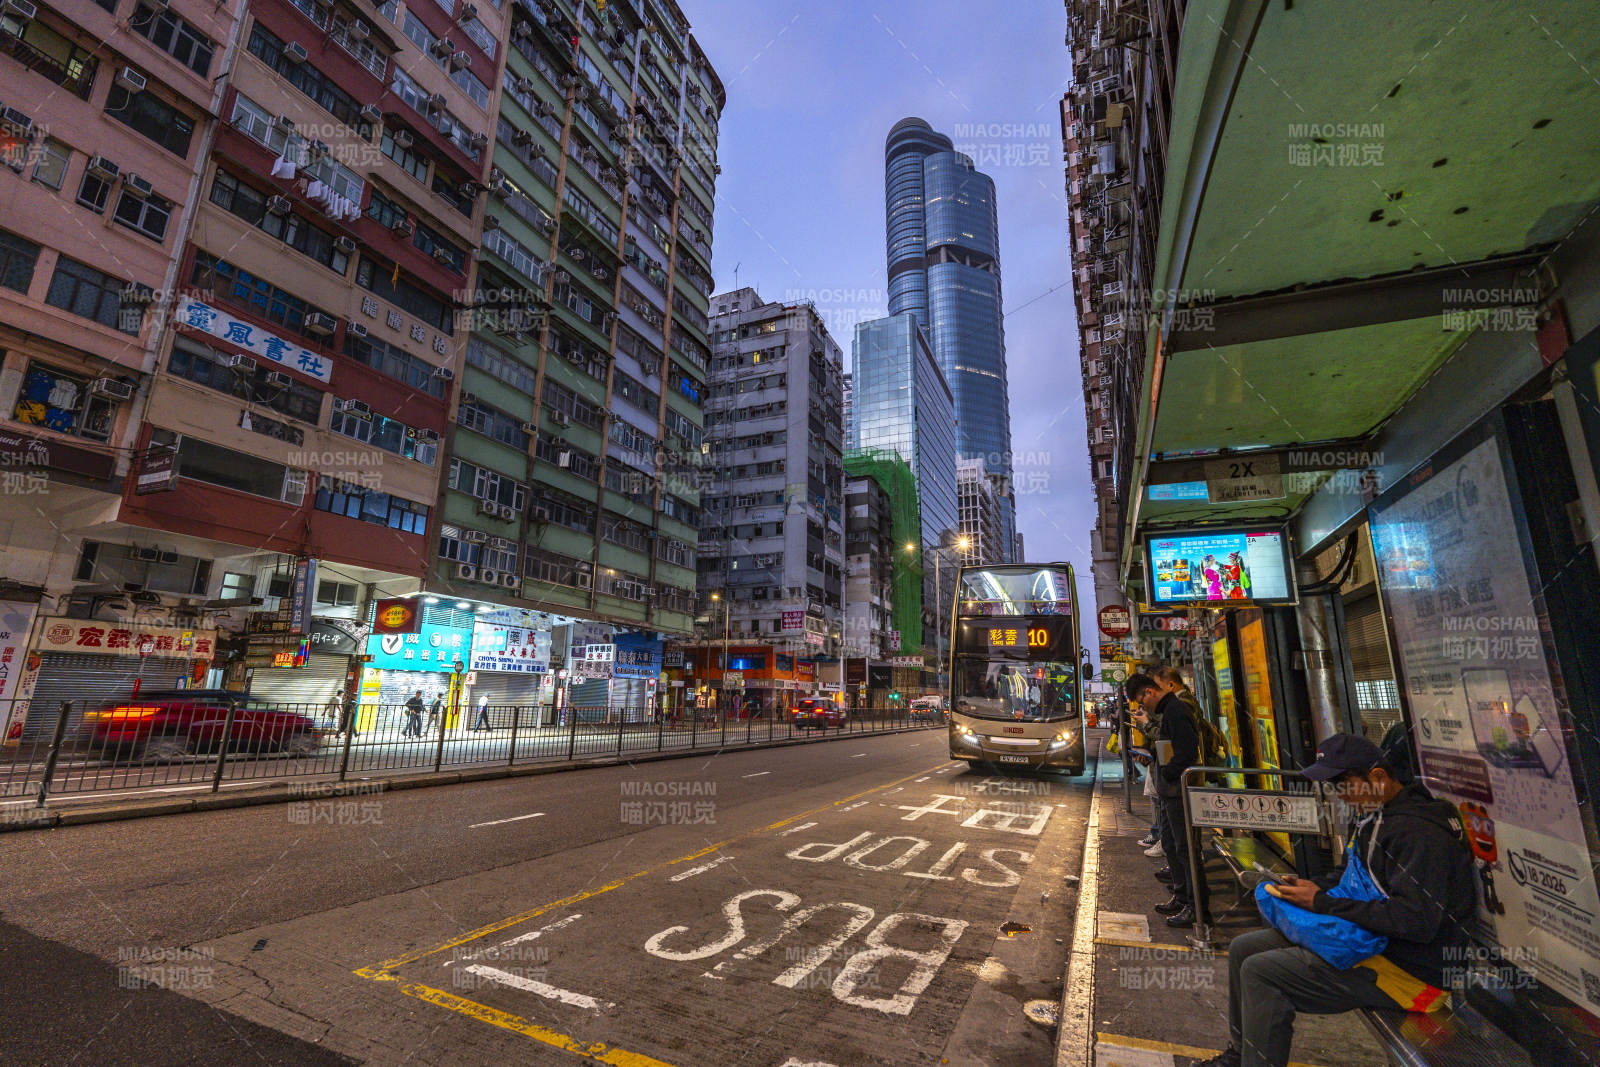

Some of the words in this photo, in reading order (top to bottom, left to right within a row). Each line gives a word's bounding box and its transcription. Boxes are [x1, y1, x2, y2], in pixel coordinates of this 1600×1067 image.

[187, 302, 325, 378] 靈風書社
[1229, 462, 1255, 478] 2X
[989, 629, 1018, 641] 彩雲
[1028, 628, 1048, 646] 10
[478, 655, 497, 663] CHONG
[785, 831, 1034, 888] STOP
[1527, 865, 1539, 883] 18
[1539, 871, 1567, 895] 2026
[644, 888, 970, 1016] BUS
